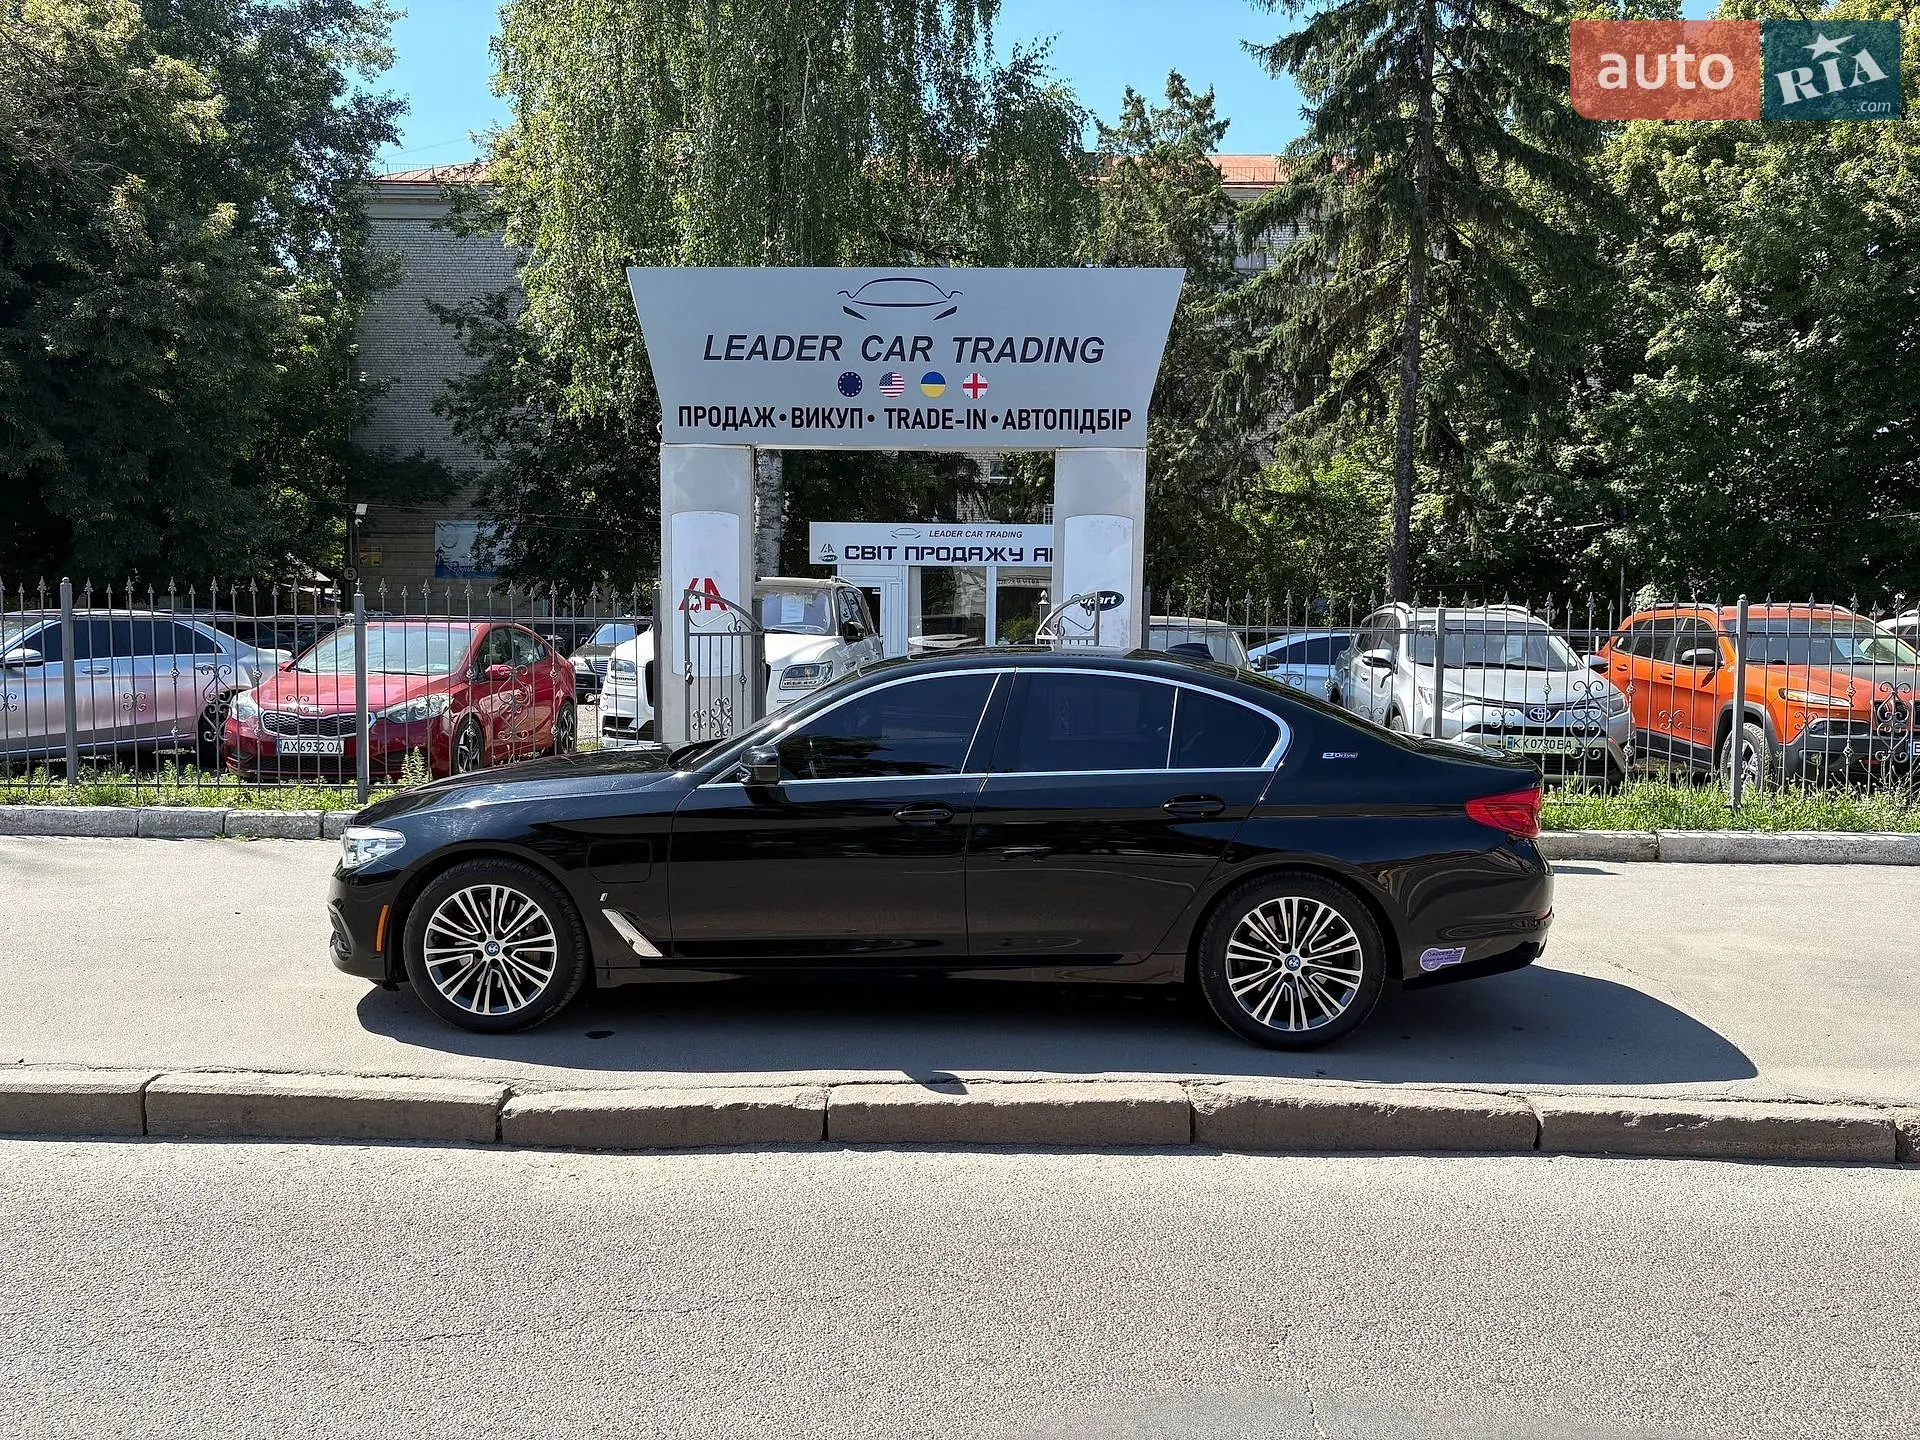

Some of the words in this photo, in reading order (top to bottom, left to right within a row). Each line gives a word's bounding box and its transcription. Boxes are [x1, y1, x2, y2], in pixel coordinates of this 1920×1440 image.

[703, 334, 843, 361] LEADER
[861, 335, 934, 362] CAR
[952, 336, 1105, 363] TRADING
[678, 405, 777, 431] ПРОДАЖ
[791, 407, 863, 429] ВИКУП
[883, 408, 987, 430] TRADE-IN
[1002, 408, 1132, 434] АВТОПІДБІР
[929, 530, 963, 538] LEADER
[965, 530, 983, 538] CAR
[985, 531, 1023, 539] TRADING
[844, 545, 898, 561] СВІТ
[904, 546, 1024, 563] ПРОДАЖУ
[1033, 547, 1053, 562] А
